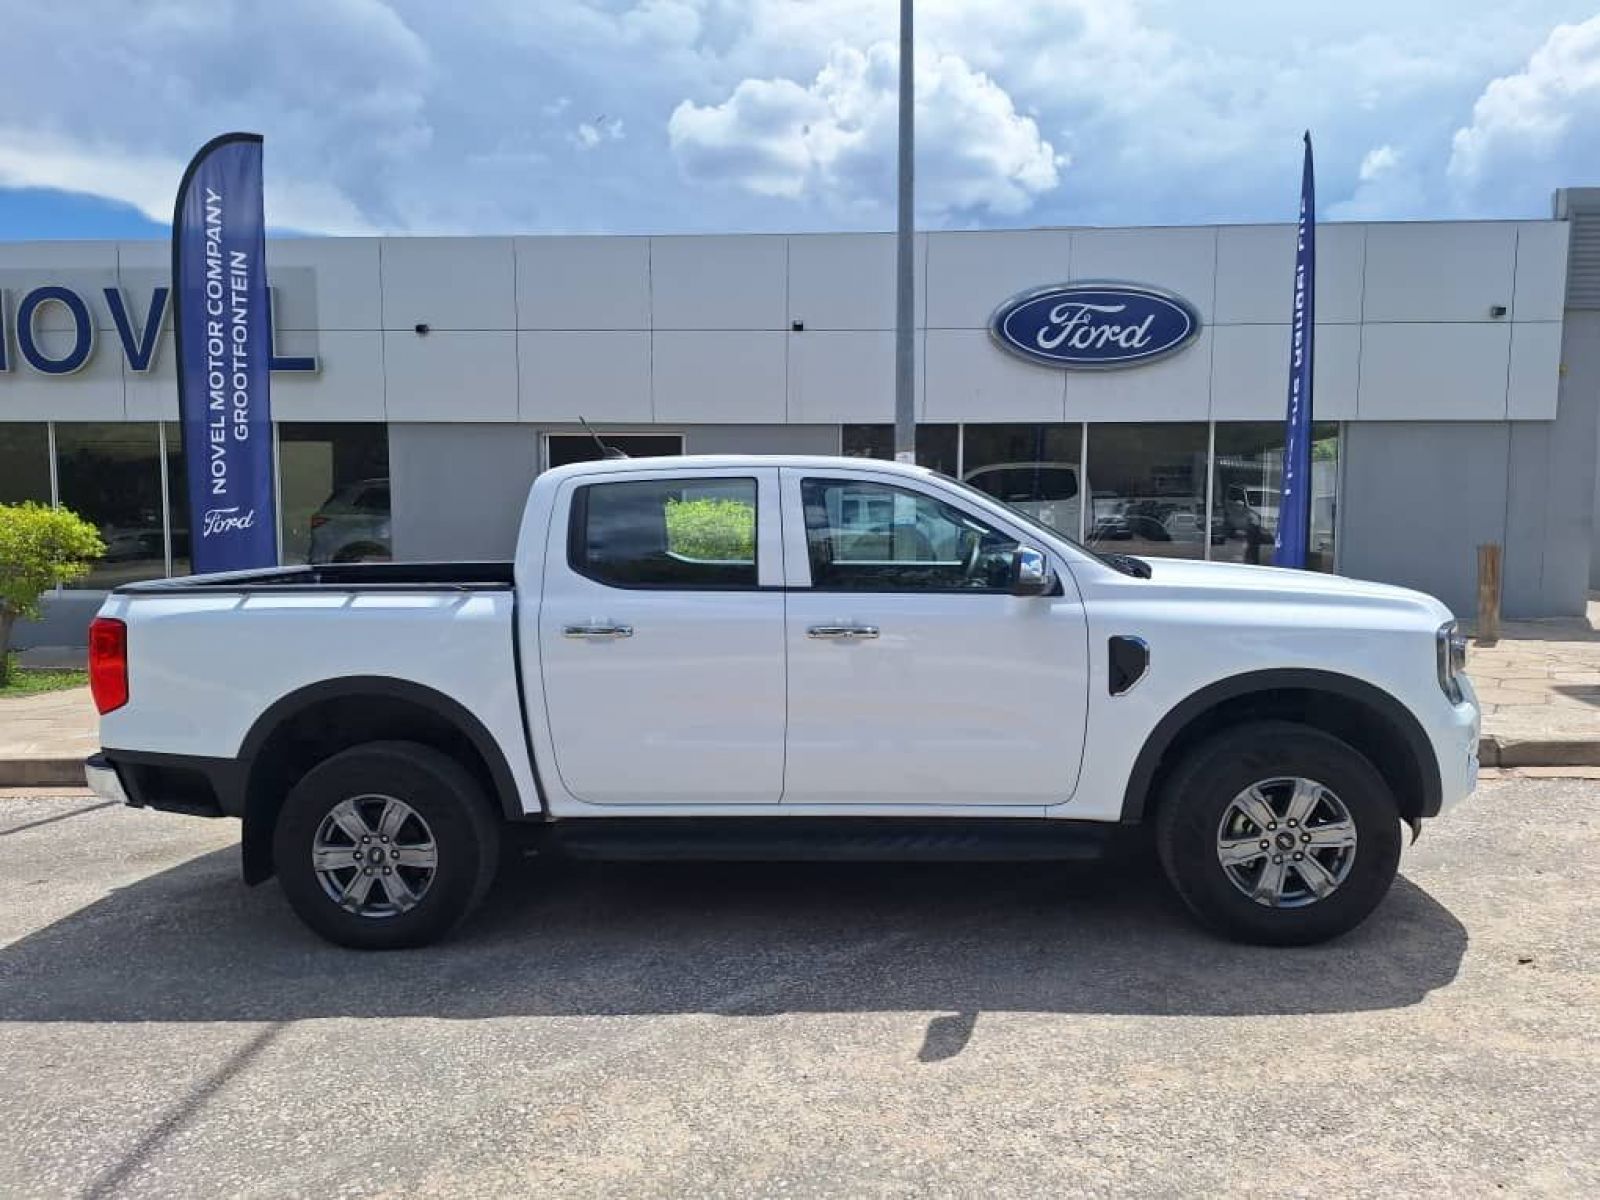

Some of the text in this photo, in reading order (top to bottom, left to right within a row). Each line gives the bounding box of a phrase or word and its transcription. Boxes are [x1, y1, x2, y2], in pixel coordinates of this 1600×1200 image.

[0, 286, 317, 374] OVL
[206, 187, 227, 495] NOVEL MOTOR COMPANY
[230, 250, 249, 442] GROOTFONTEIN
[1036, 302, 1155, 349] Ford
[203, 506, 255, 538] Ford
